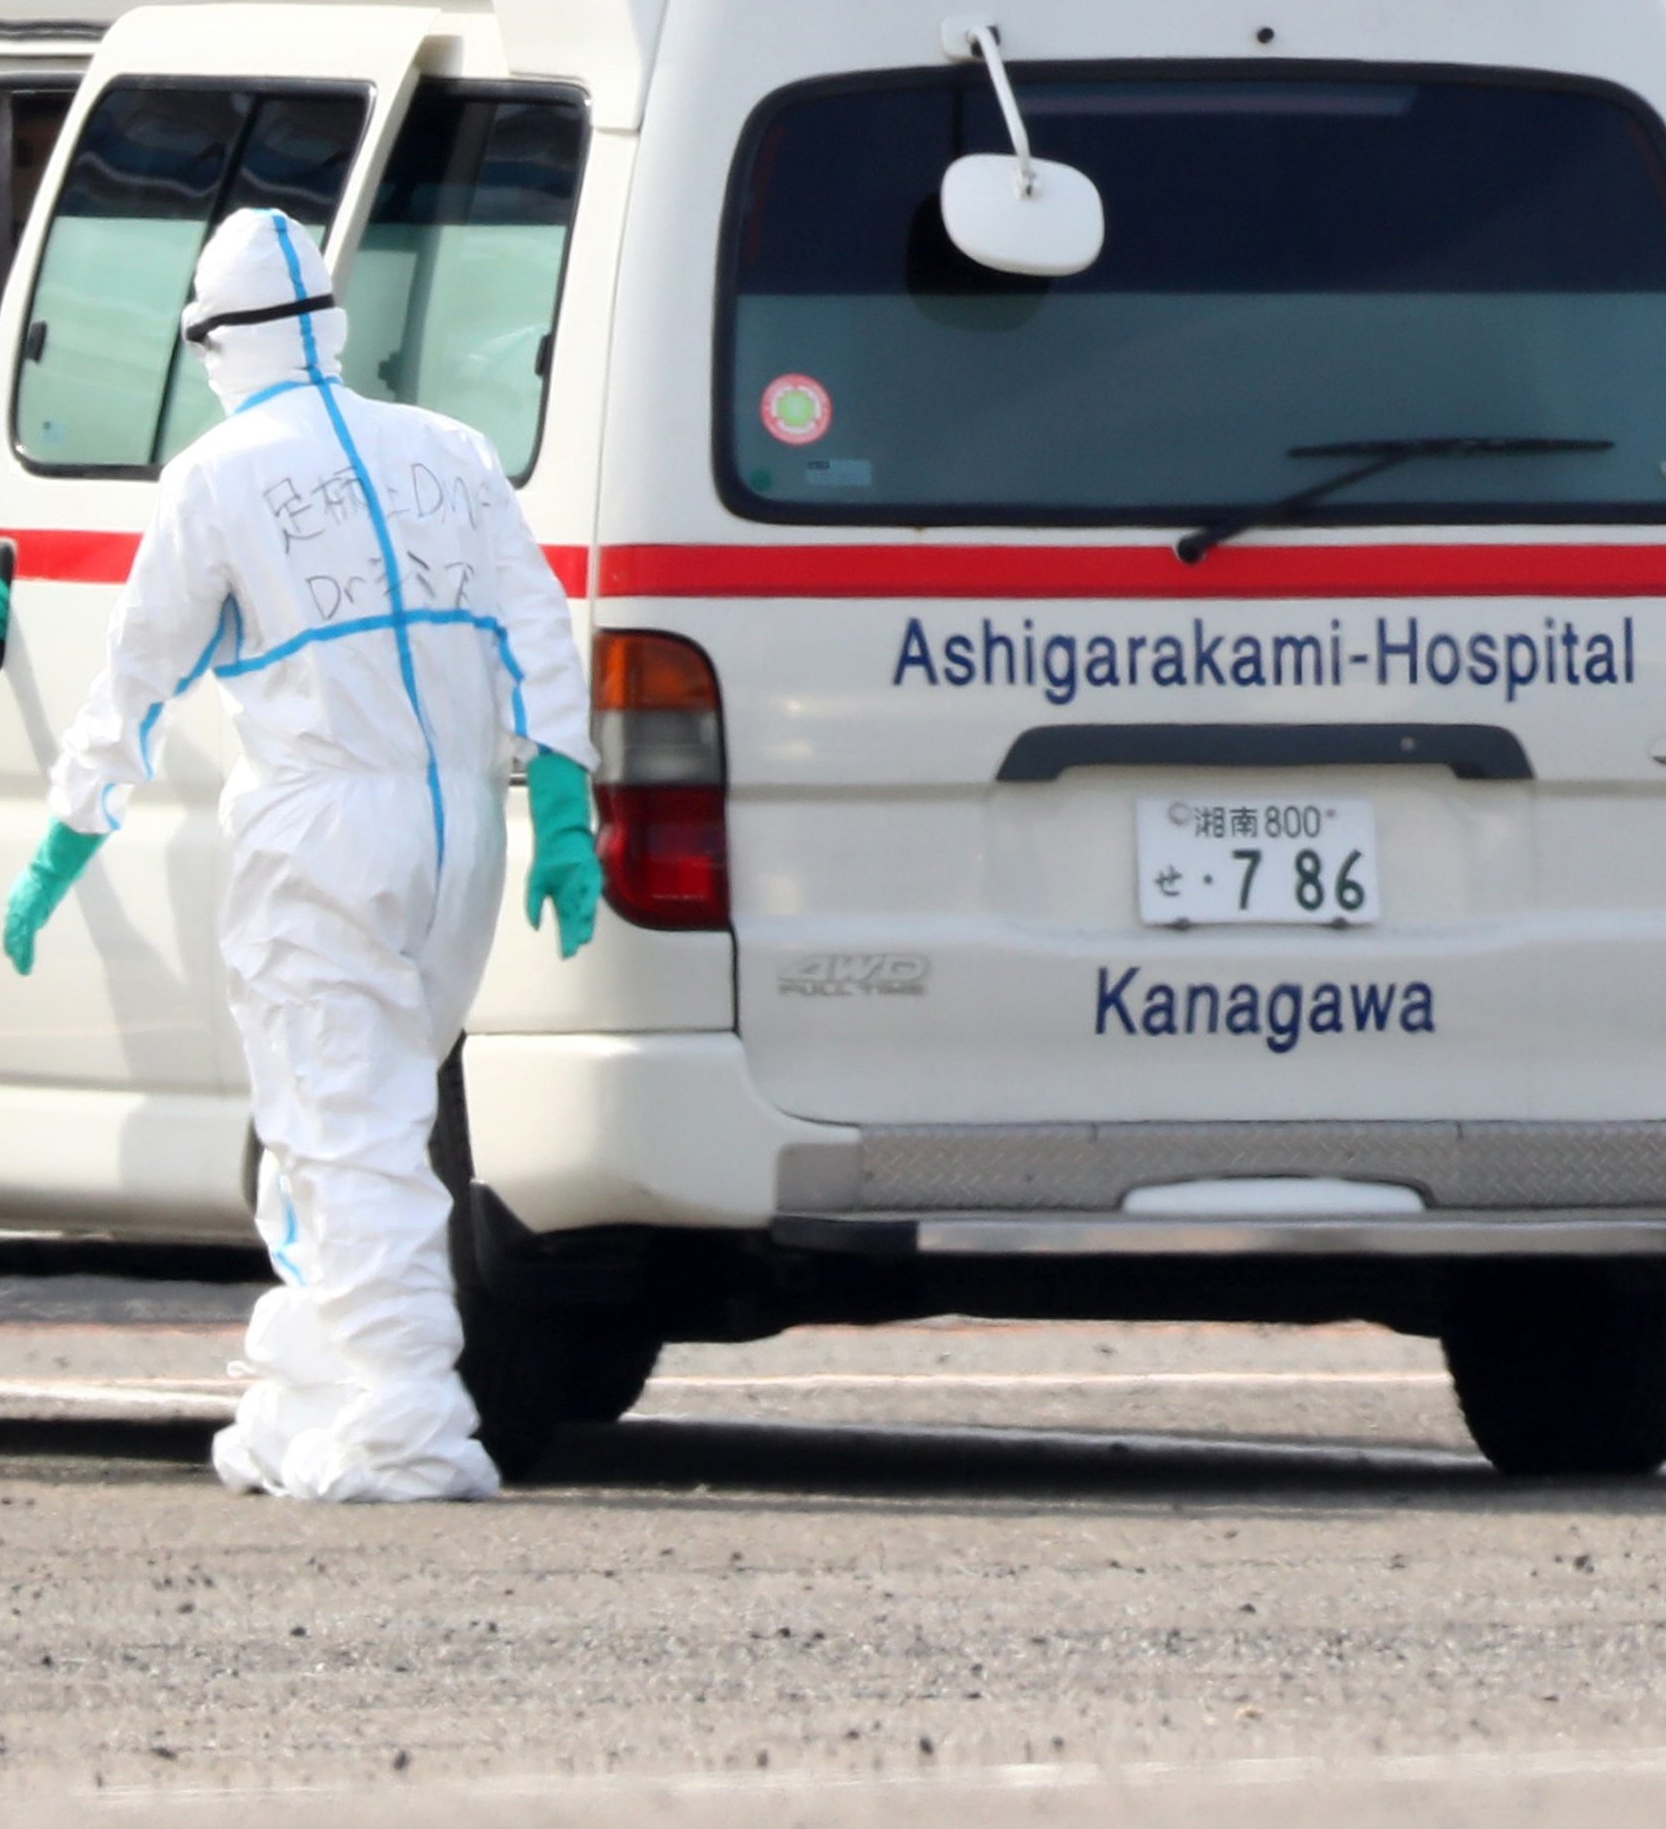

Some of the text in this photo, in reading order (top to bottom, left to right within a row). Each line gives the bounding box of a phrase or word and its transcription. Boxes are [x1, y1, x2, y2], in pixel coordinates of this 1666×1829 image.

[892, 616, 1635, 706] Ashigarakami-Hospital
[1264, 804, 1323, 839] 800
[1154, 864, 1183, 898] せ
[1094, 966, 1436, 1054] Kanagawa
